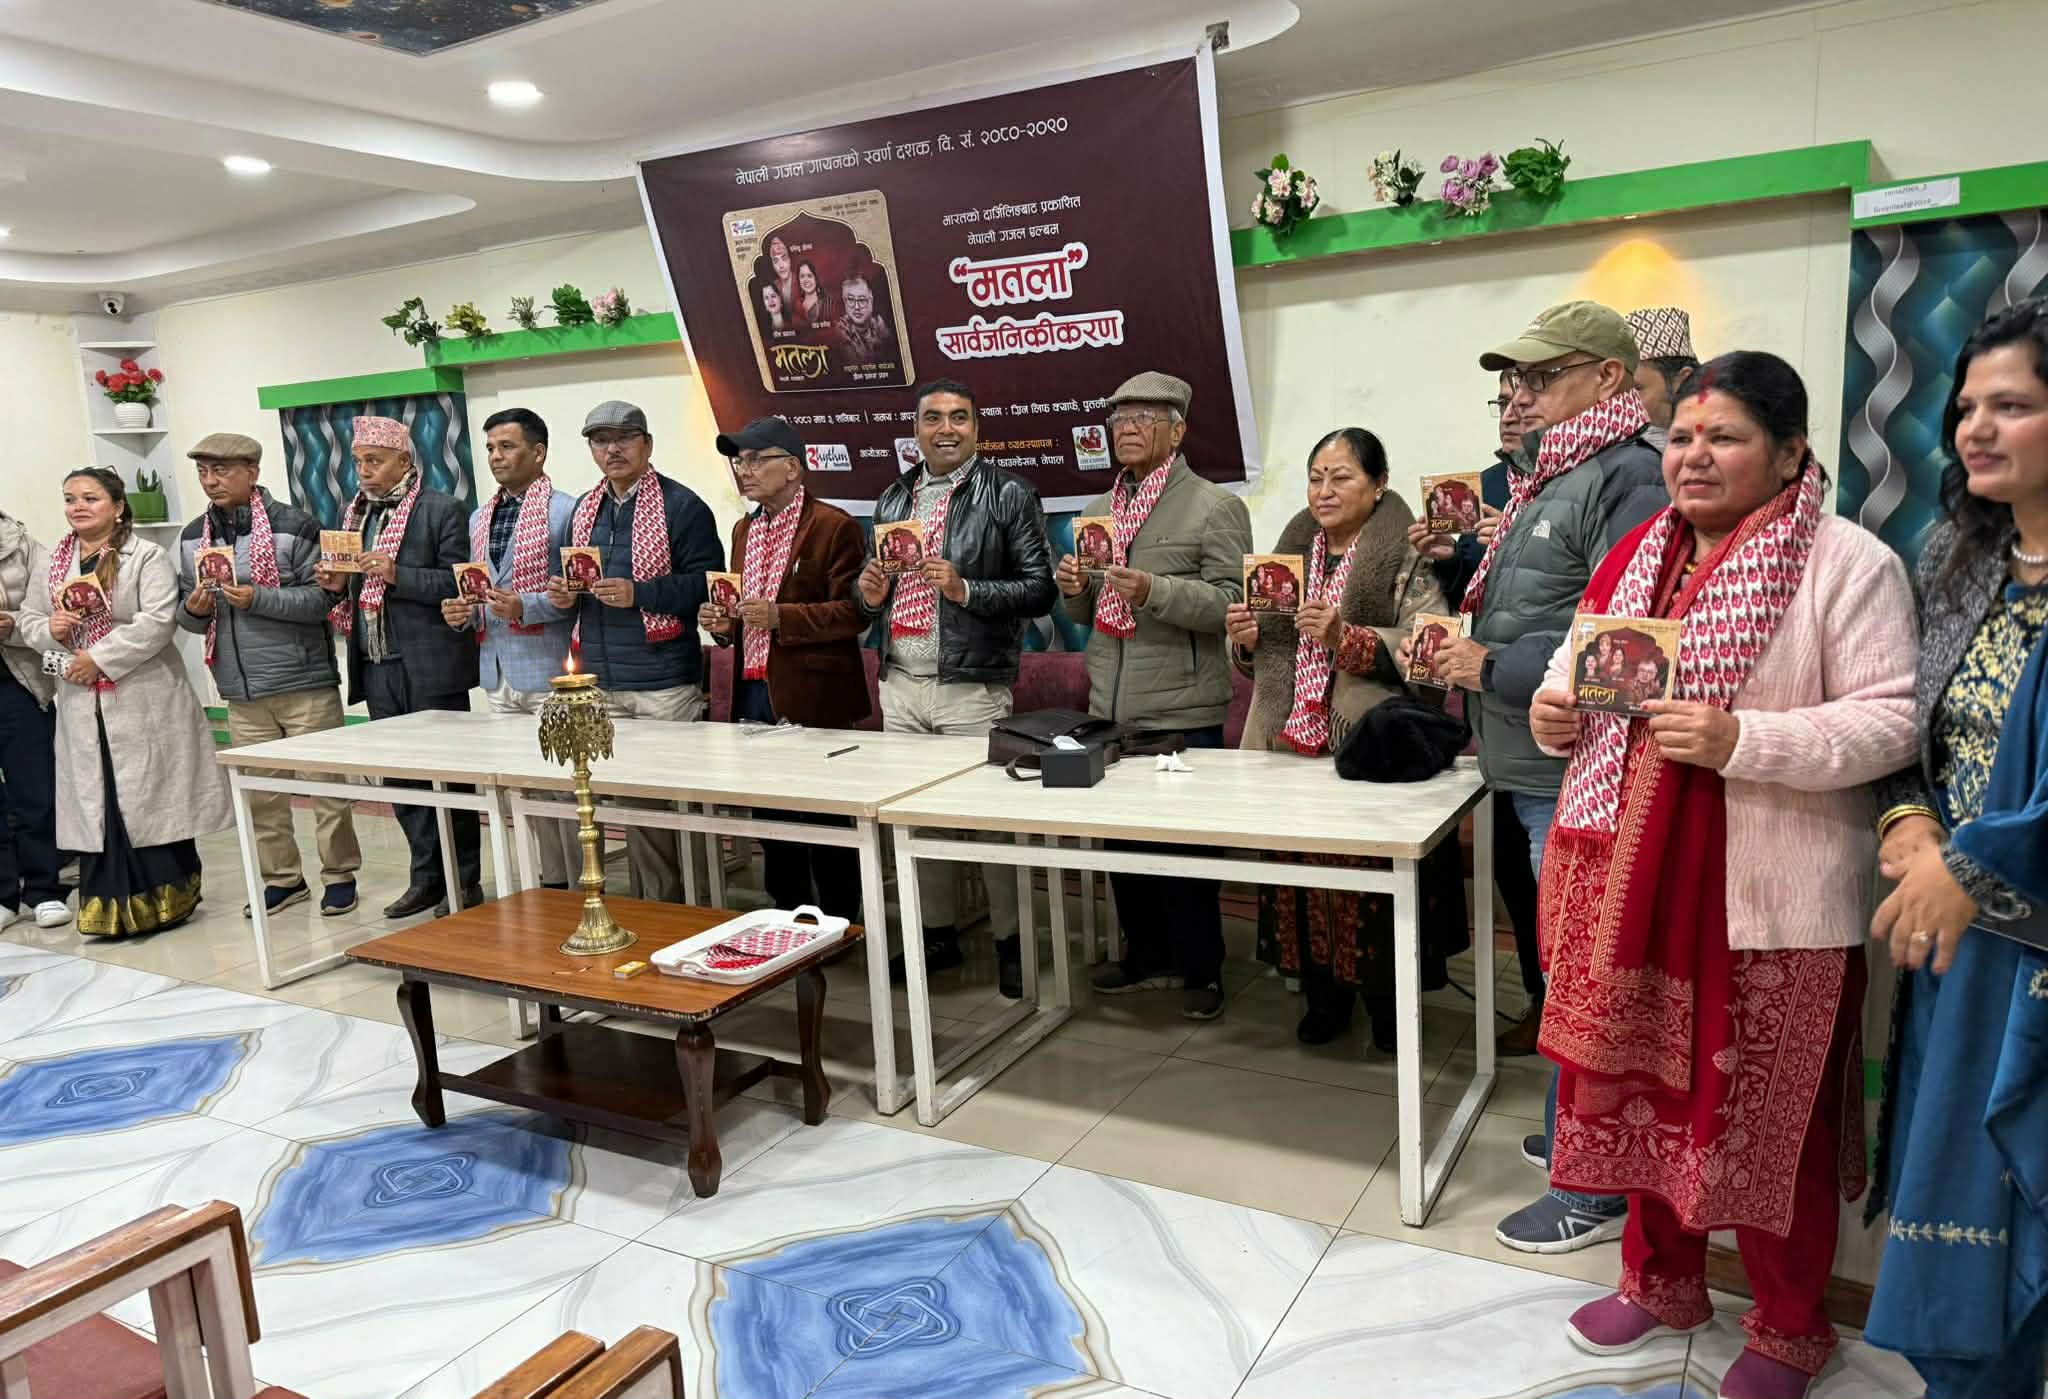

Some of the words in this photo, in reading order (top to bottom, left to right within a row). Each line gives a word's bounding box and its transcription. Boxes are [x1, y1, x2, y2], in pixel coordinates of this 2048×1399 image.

[735, 166, 769, 185] नेपाली
[773, 162, 804, 180] गजल
[808, 148, 860, 174] गायनको
[863, 141, 892, 165] स्वर्ण
[896, 140, 933, 160] दशक,
[937, 134, 955, 152] वि.
[960, 130, 975, 149] सं.
[980, 117, 1068, 145] २०८०-२०९०
[1040, 195, 1081, 214] प्रकाशित
[967, 230, 996, 246] नेपाली
[999, 228, 1026, 241] गजल
[1029, 223, 1060, 238] एल्बम
[941, 317, 1119, 354] सार्वजनिकीकरण
[1579, 685, 1617, 705] मतला
